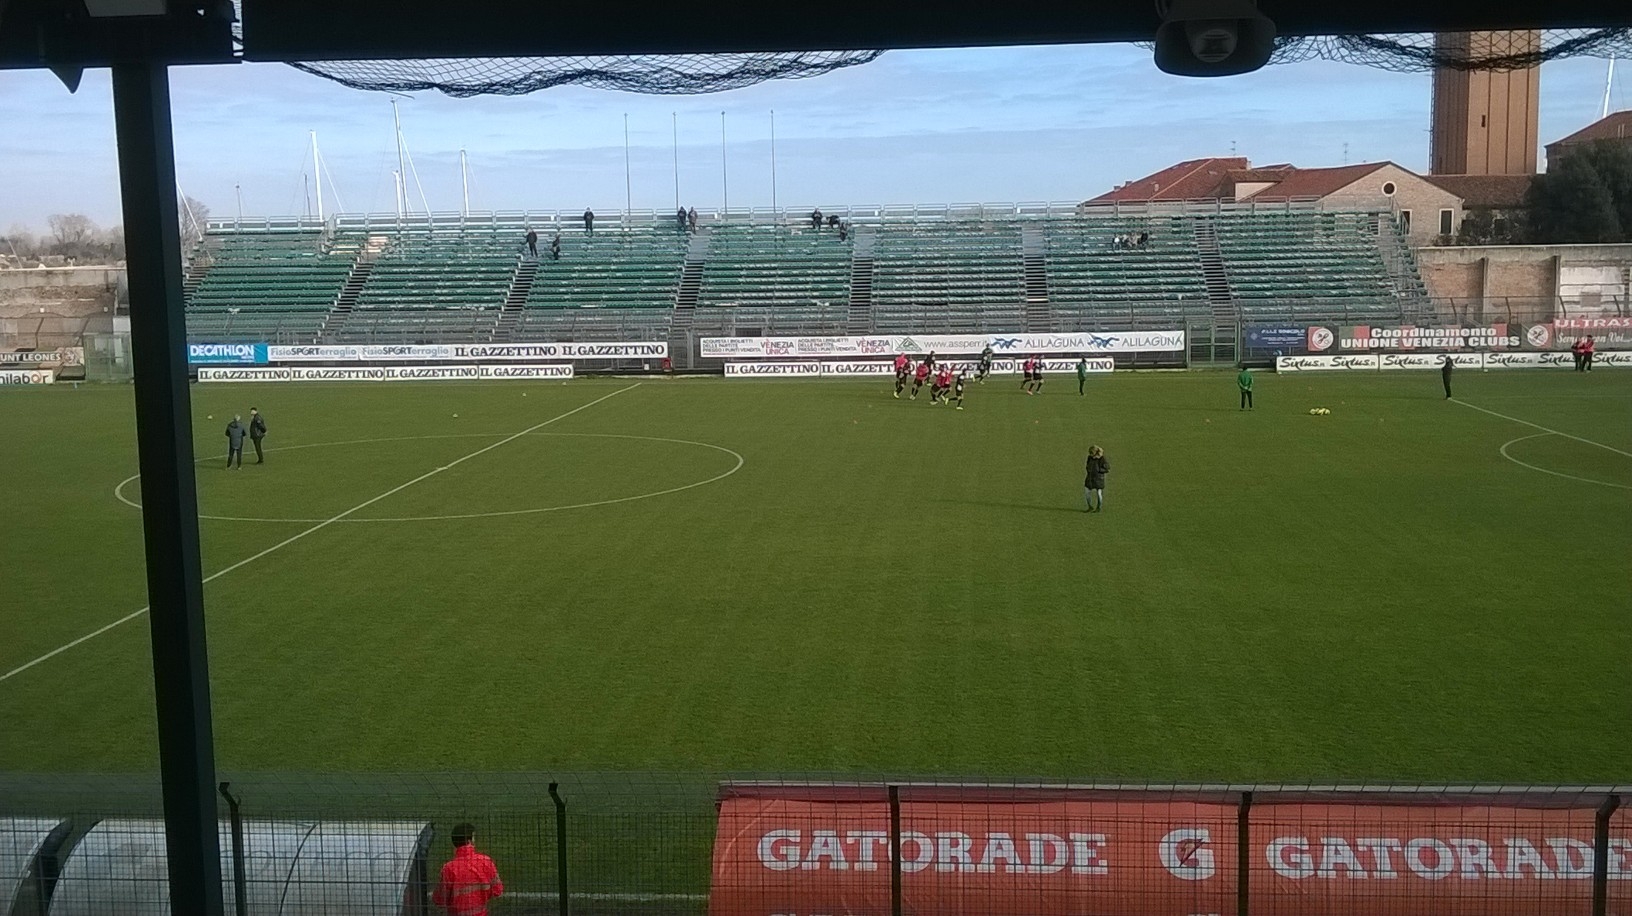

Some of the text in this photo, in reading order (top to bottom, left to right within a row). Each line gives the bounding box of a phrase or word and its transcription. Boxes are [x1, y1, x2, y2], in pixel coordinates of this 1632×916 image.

[1555, 318, 1630, 328] ULTRAS
[1371, 327, 1497, 338] Coordinamento
[1024, 337, 1085, 348] ALILAGUNA
[1121, 336, 1184, 347] ALILAGUNA
[1340, 336, 1521, 348] UNIONE VENEZIA CLUBS
[190, 344, 255, 356] DECATHLON
[454, 346, 557, 357] IL GAZZETTINO
[562, 345, 665, 356] IL GAZZETTINO
[861, 346, 886, 354] UNICA
[22, 353, 61, 361] LEONES
[292, 369, 384, 379] IL GAZZETTINO
[386, 368, 477, 378] IL GAZZETTINO
[480, 367, 572, 377] IL GAZZETTINO
[726, 364, 819, 374] IL GAZZETTINO
[822, 364, 834, 373] IL
[199, 369, 290, 380] IL GAZZETTINO
[757, 828, 1632, 881] GATORADE G GATORADE
